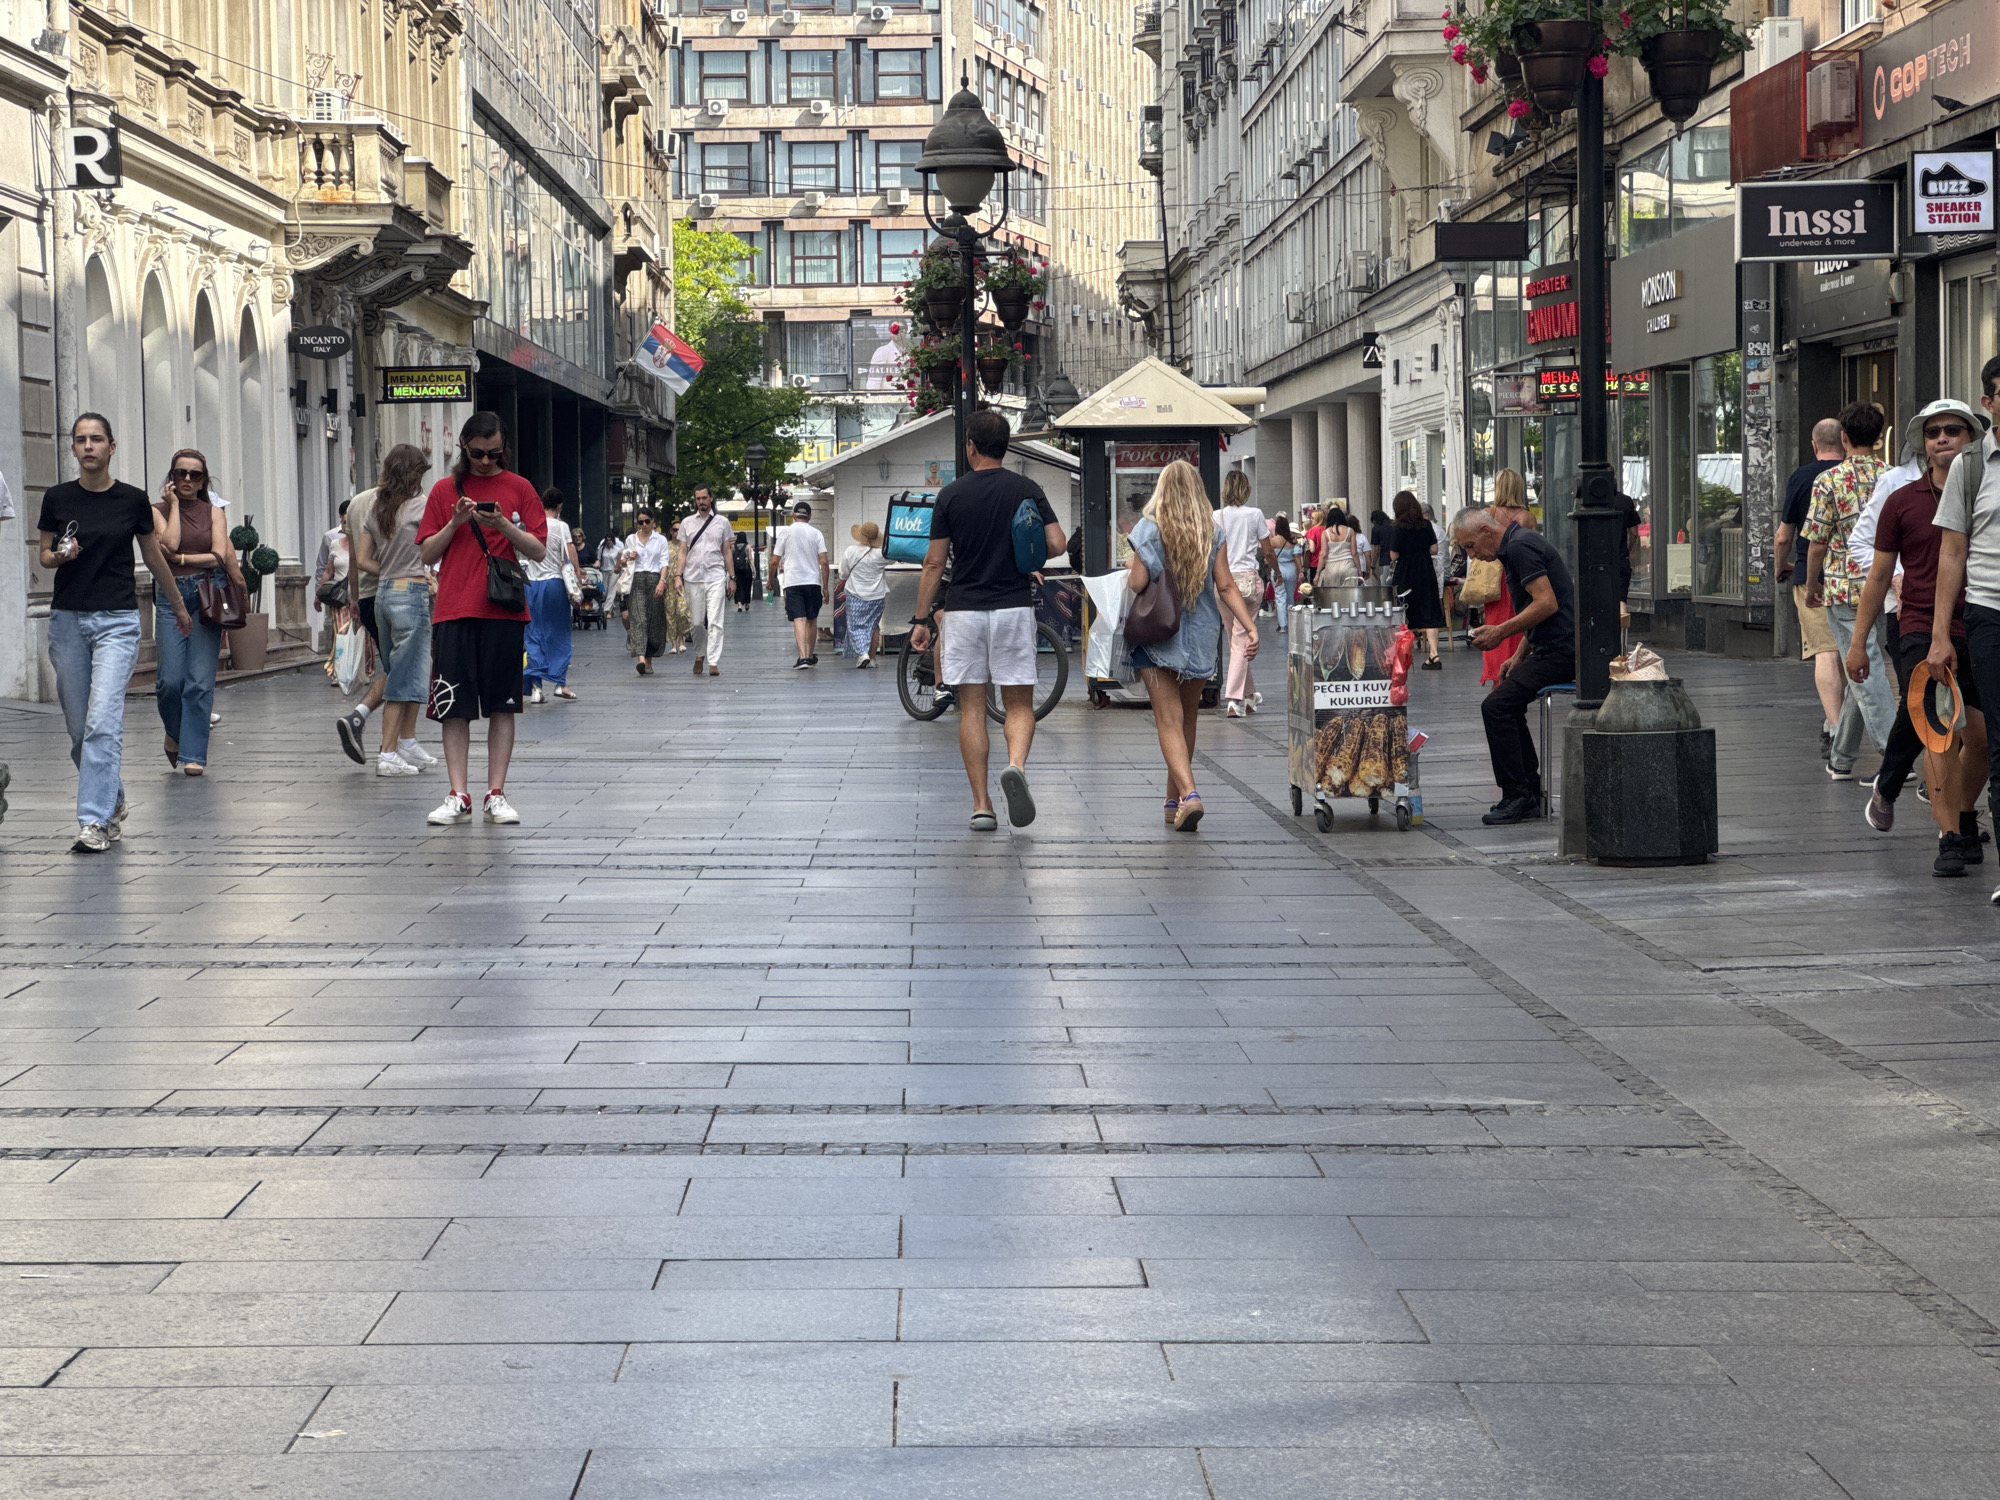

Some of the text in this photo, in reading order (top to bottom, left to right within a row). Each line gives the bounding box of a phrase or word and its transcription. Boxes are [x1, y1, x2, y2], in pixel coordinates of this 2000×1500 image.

[1890, 33, 1971, 103] COPTECH
[64, 127, 117, 186] R
[1927, 180, 1971, 195] BUZZ
[1926, 201, 1982, 213] SNEAKER
[1767, 199, 1868, 236] Inssi
[1928, 212, 1980, 224] STATION
[1779, 239, 1823, 247] underwear
[1825, 238, 1832, 246] &
[1536, 274, 1569, 296] CENTER
[1641, 269, 1677, 309] MONSOON
[1646, 313, 1670, 334] CHILDREN
[299, 335, 346, 345] INCANTO
[390, 373, 463, 383] MENJAČNICA
[1569, 383, 1578, 392] €
[1120, 450, 1194, 462] POPCORN
[894, 516, 923, 532] Wolt
[1314, 683, 1351, 693] PEČEN
[1354, 683, 1360, 692] I
[1330, 696, 1389, 706] KUKURUZ
